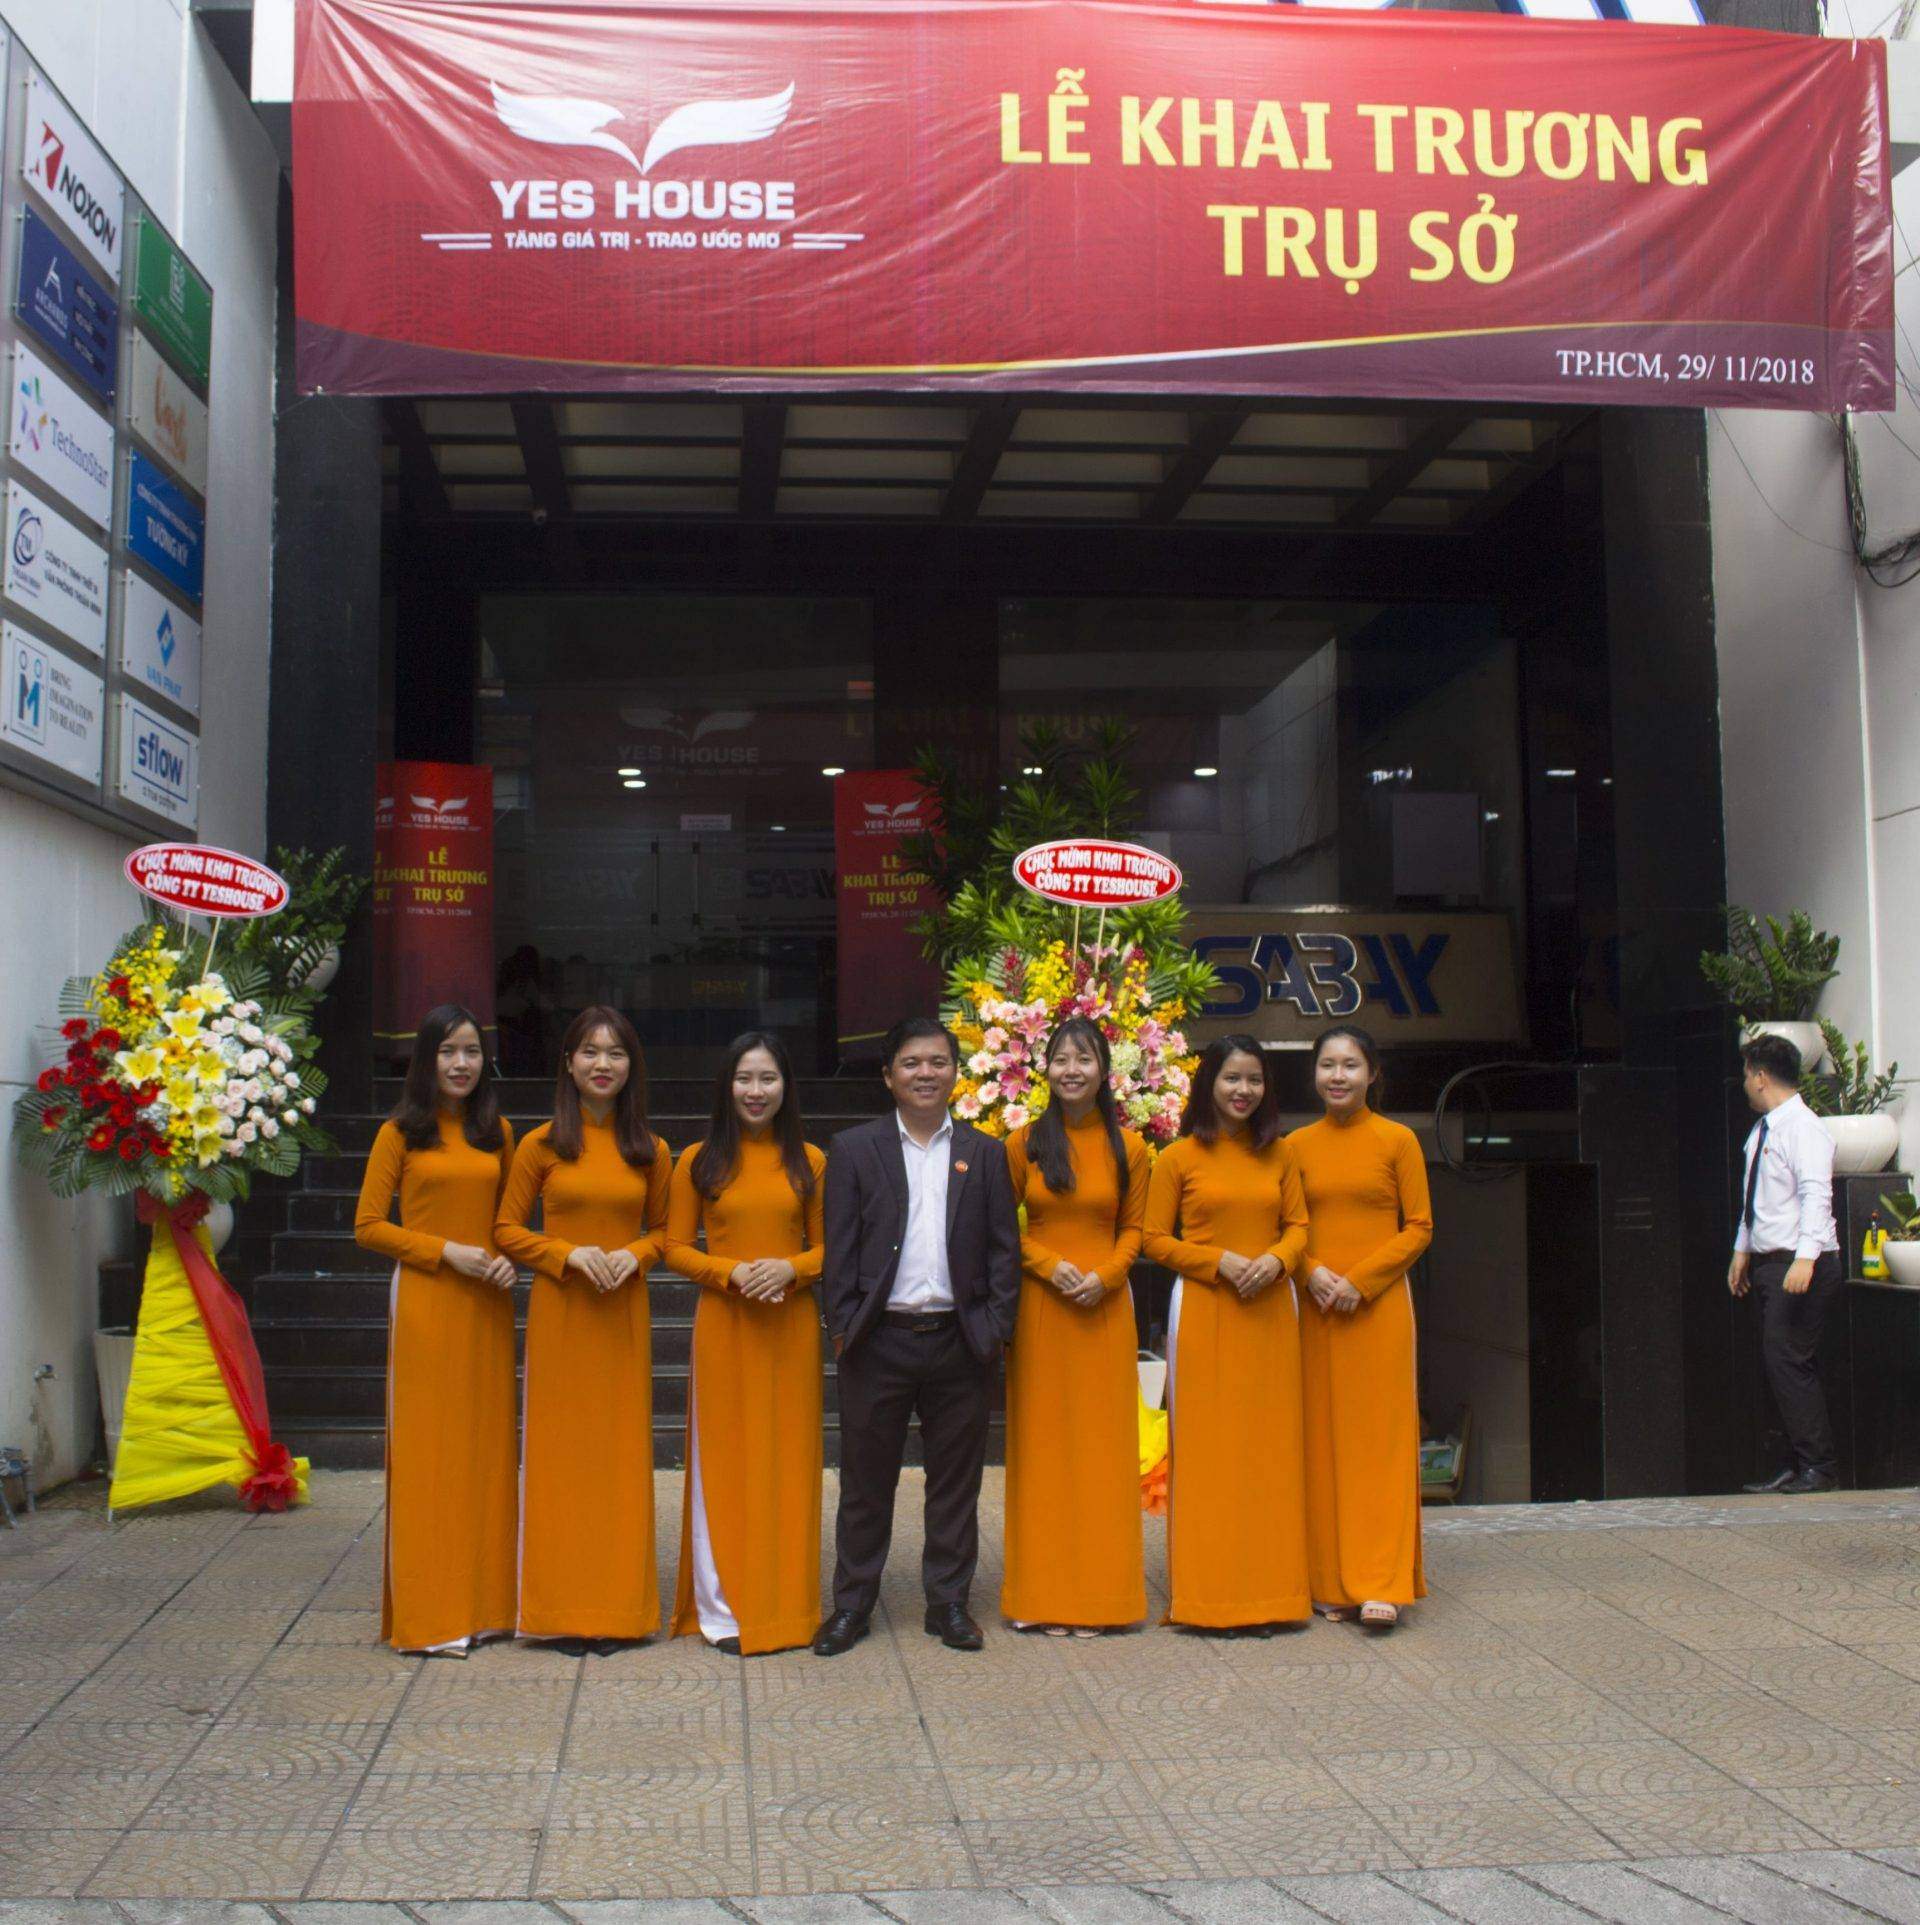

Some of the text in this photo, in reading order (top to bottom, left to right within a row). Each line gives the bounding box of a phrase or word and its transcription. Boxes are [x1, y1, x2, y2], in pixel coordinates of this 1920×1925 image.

[1000, 67, 1709, 187] LỄ KHAI TRƯƠNG
[59, 163, 117, 254] NOXON
[490, 180, 796, 220] YES HOUSE
[504, 229, 558, 249] TĂNG
[562, 228, 595, 248] GIÁ
[600, 231, 630, 251] TRỊ
[646, 231, 697, 249] TRAO
[1206, 193, 1519, 295] TRỤ SỞ
[1556, 350, 1815, 385] TP.HCM, 29/ 11/2018
[138, 732, 184, 787] sflow
[411, 812, 470, 826] YES HOUSE
[864, 818, 922, 829] YES HOUSE
[204, 856, 233, 881] KHAI
[1093, 850, 1123, 872] KHAI
[144, 870, 267, 912] CÔNG TY YESHOUSE
[843, 874, 879, 889] KHAI
[1035, 867, 1158, 897] CÔNG TY YESHOUSE
[1189, 932, 1450, 1017] SABAY
